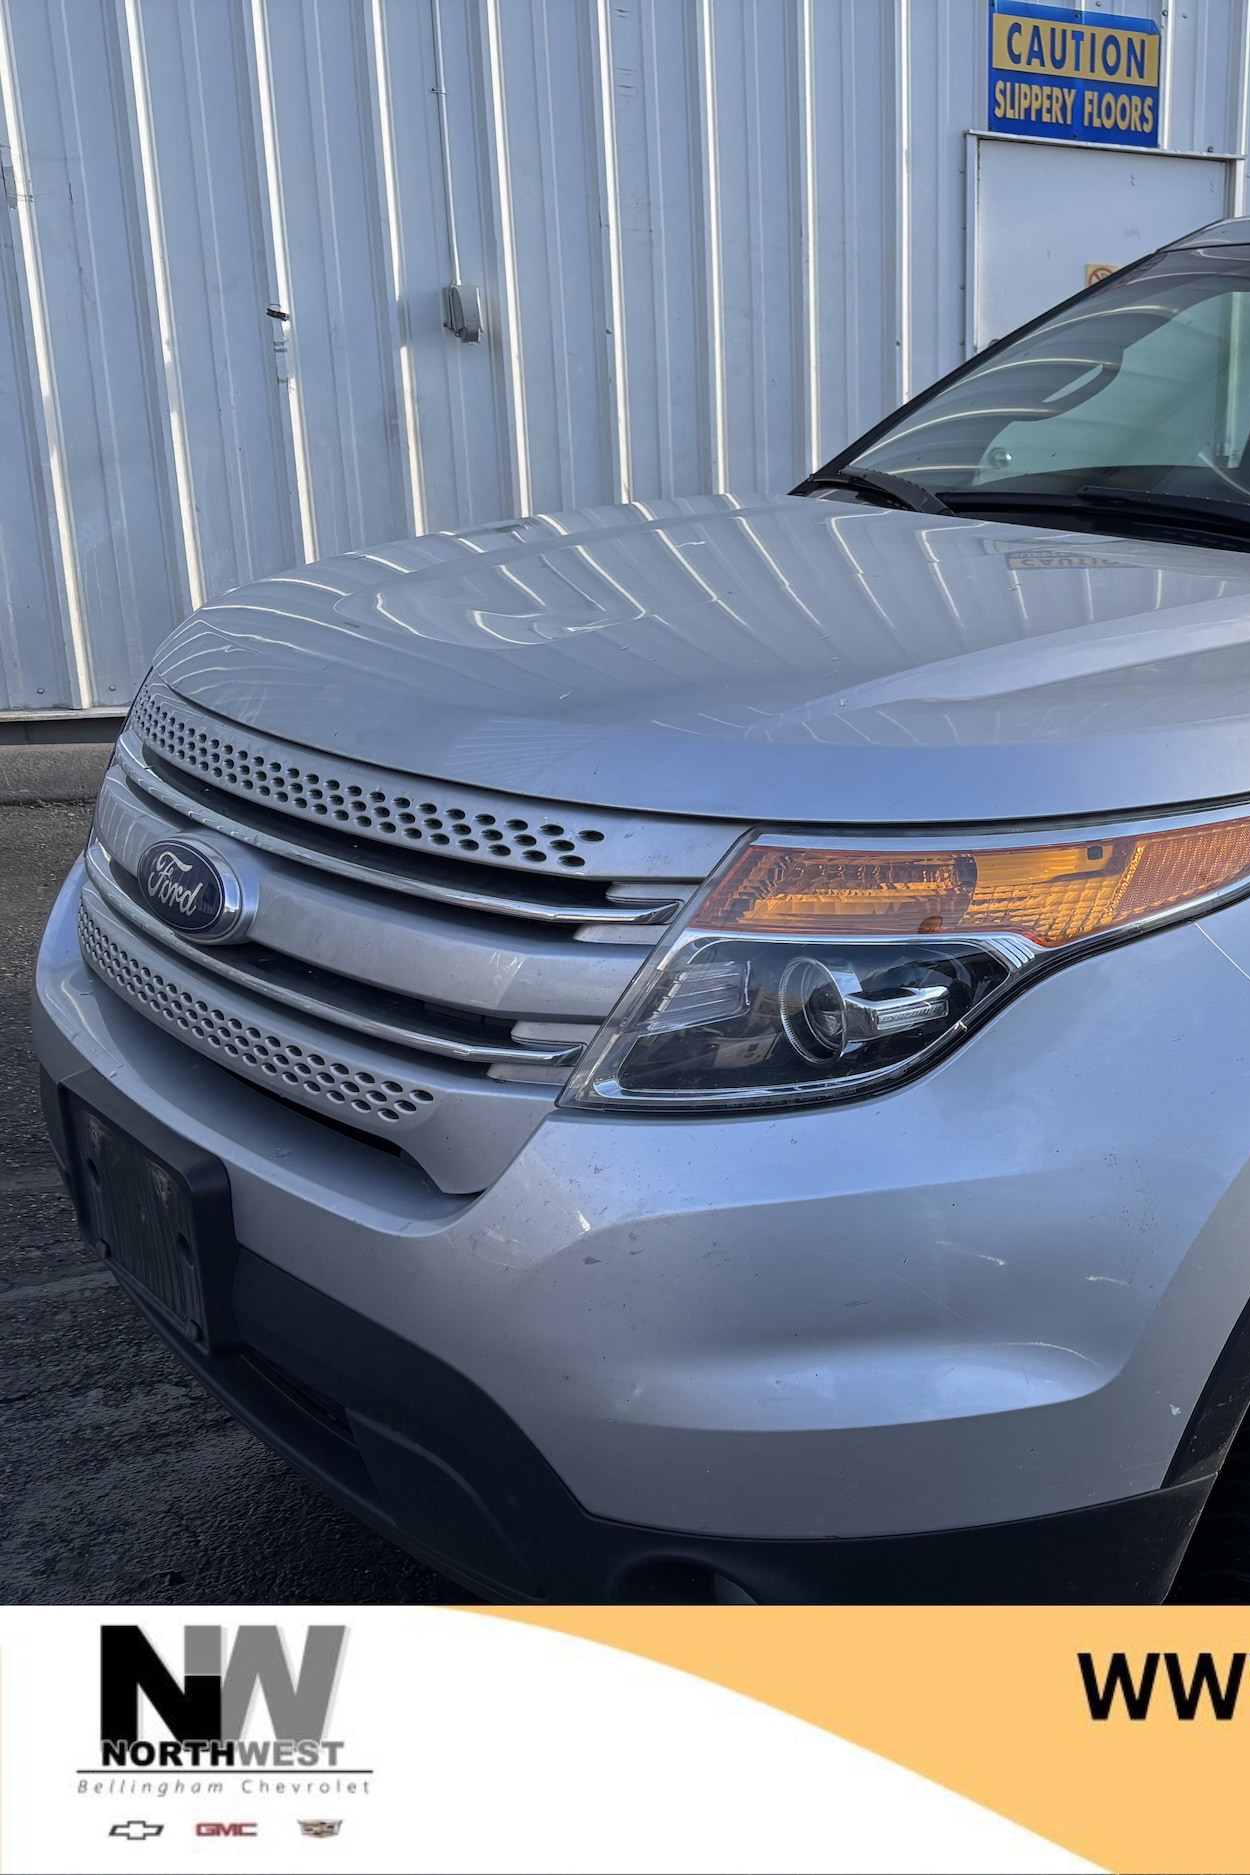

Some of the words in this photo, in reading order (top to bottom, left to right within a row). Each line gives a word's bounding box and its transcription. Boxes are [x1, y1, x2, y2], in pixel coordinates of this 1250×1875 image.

[1006, 22, 1147, 79] CAUTION
[994, 80, 1077, 125] SLIPPERY
[1083, 91, 1154, 133] FLOORS
[147, 851, 203, 916] Ford
